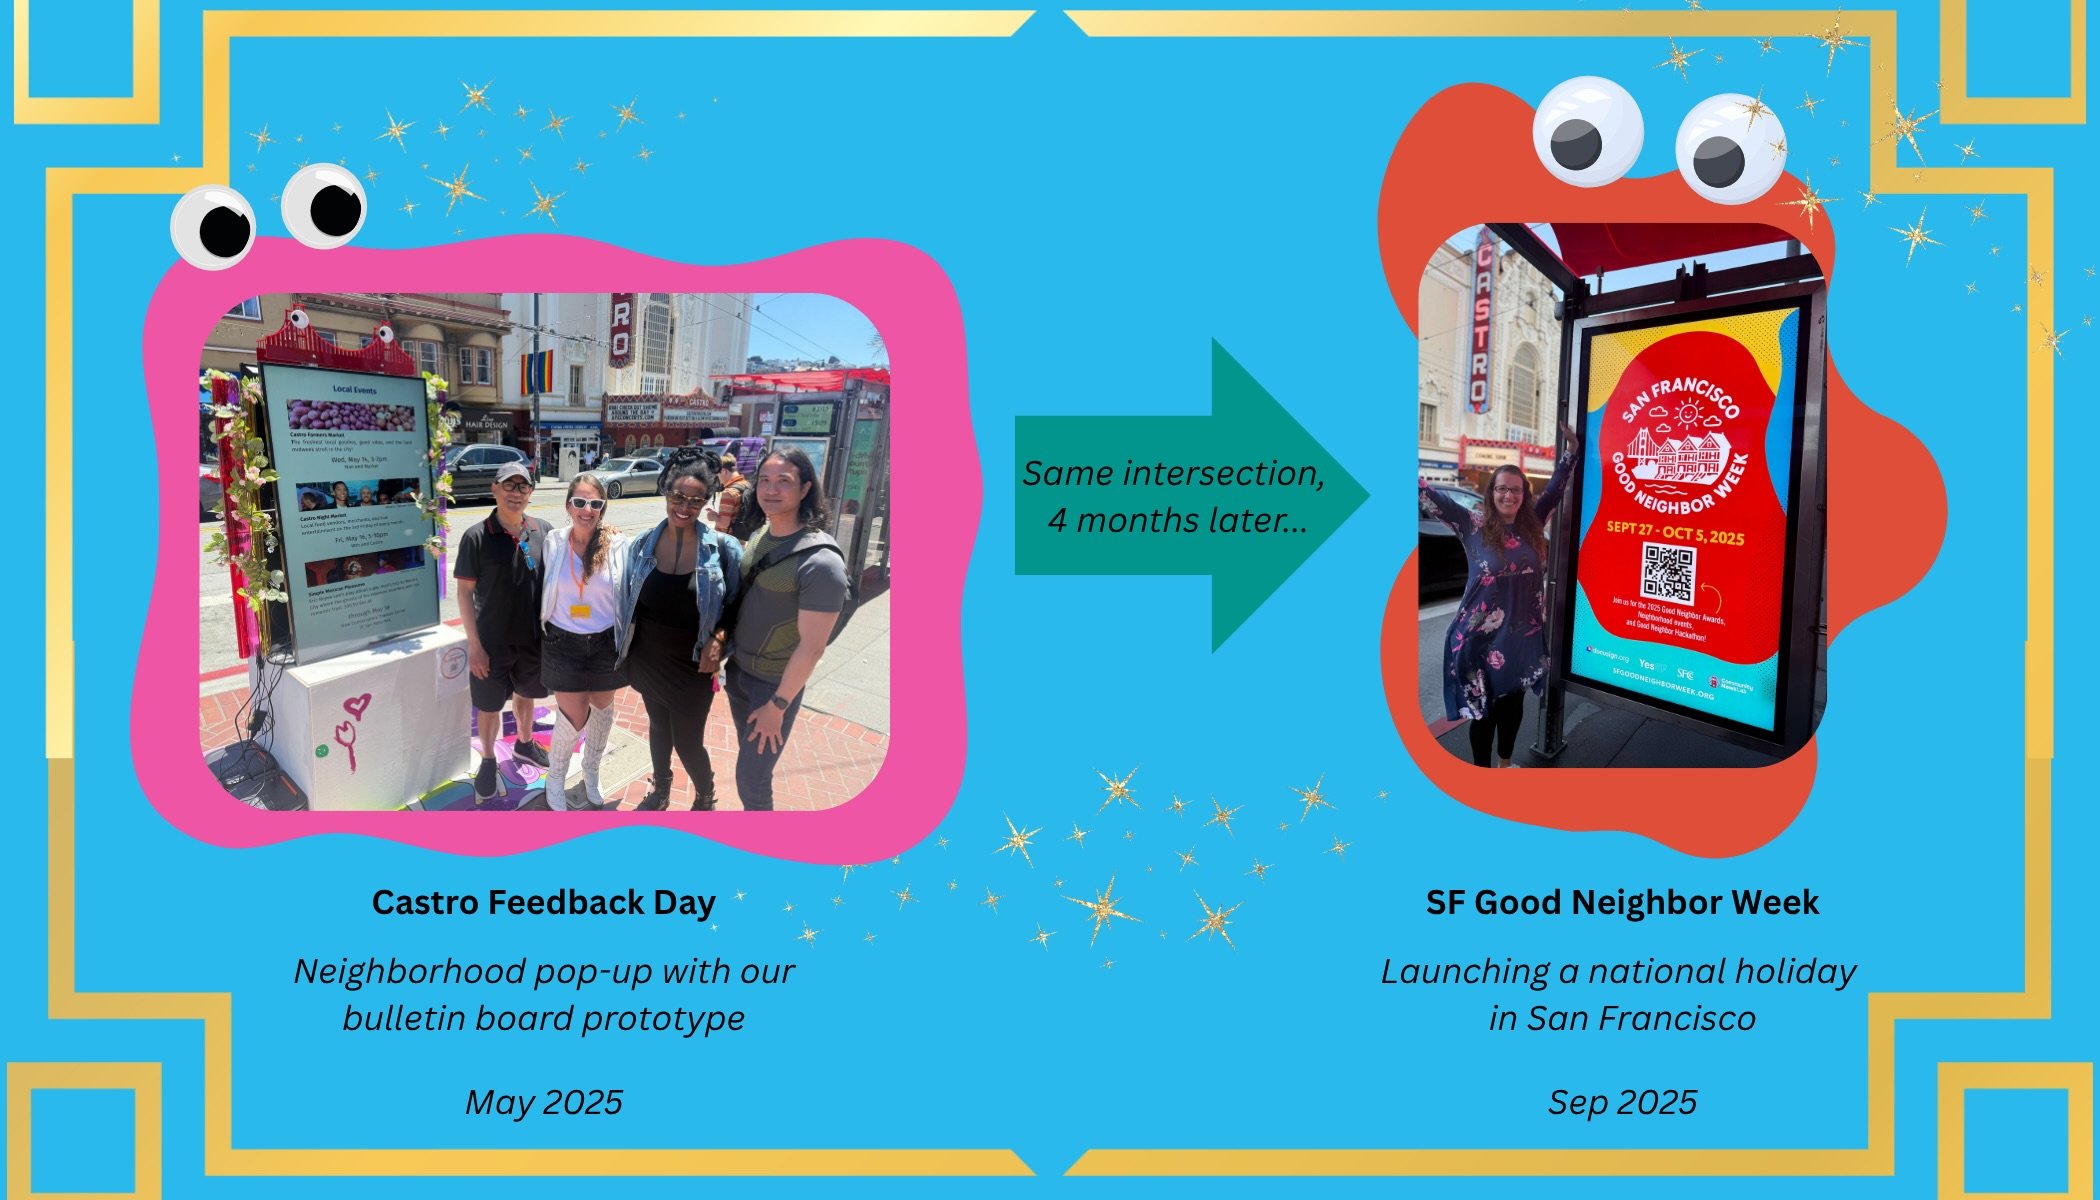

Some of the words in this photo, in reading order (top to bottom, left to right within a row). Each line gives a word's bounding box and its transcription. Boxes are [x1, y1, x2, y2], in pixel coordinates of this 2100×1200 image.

[611, 293, 630, 356] RO
[1472, 244, 1492, 401] CASTRO
[333, 385, 352, 393] Local
[354, 386, 377, 395] Events
[1622, 391, 1650, 423] SAN
[1651, 377, 1740, 419] FRANCISCO
[1613, 452, 1635, 493] GOOD
[1634, 490, 1716, 514] NEIGHBOR
[1713, 452, 1748, 499] WEEK
[1607, 521, 1637, 534] SEPT
[1638, 524, 1653, 535] 27
[1663, 526, 1694, 539] OCT
[1696, 530, 1707, 543] 5,
[1710, 531, 1745, 546] 2025
[1613, 596, 1622, 604] Join
[1638, 601, 1646, 609] the
[1648, 603, 1661, 612] 2025
[1662, 606, 1676, 614] Good
[1677, 608, 1701, 620] Neighbor
[1702, 614, 1725, 626] Awards,
[1638, 611, 1673, 625] Neighborhood
[1674, 620, 1694, 630] events,
[1637, 621, 1650, 630] Good
[1650, 624, 1674, 635] Neighbor
[1675, 628, 1706, 642] Hackathon!
[1592, 648, 1630, 664] docusign.org
[1613, 668, 1714, 700] SFGOODNEIGHBORWEEK.ORG
[1721, 678, 1754, 692] Community
